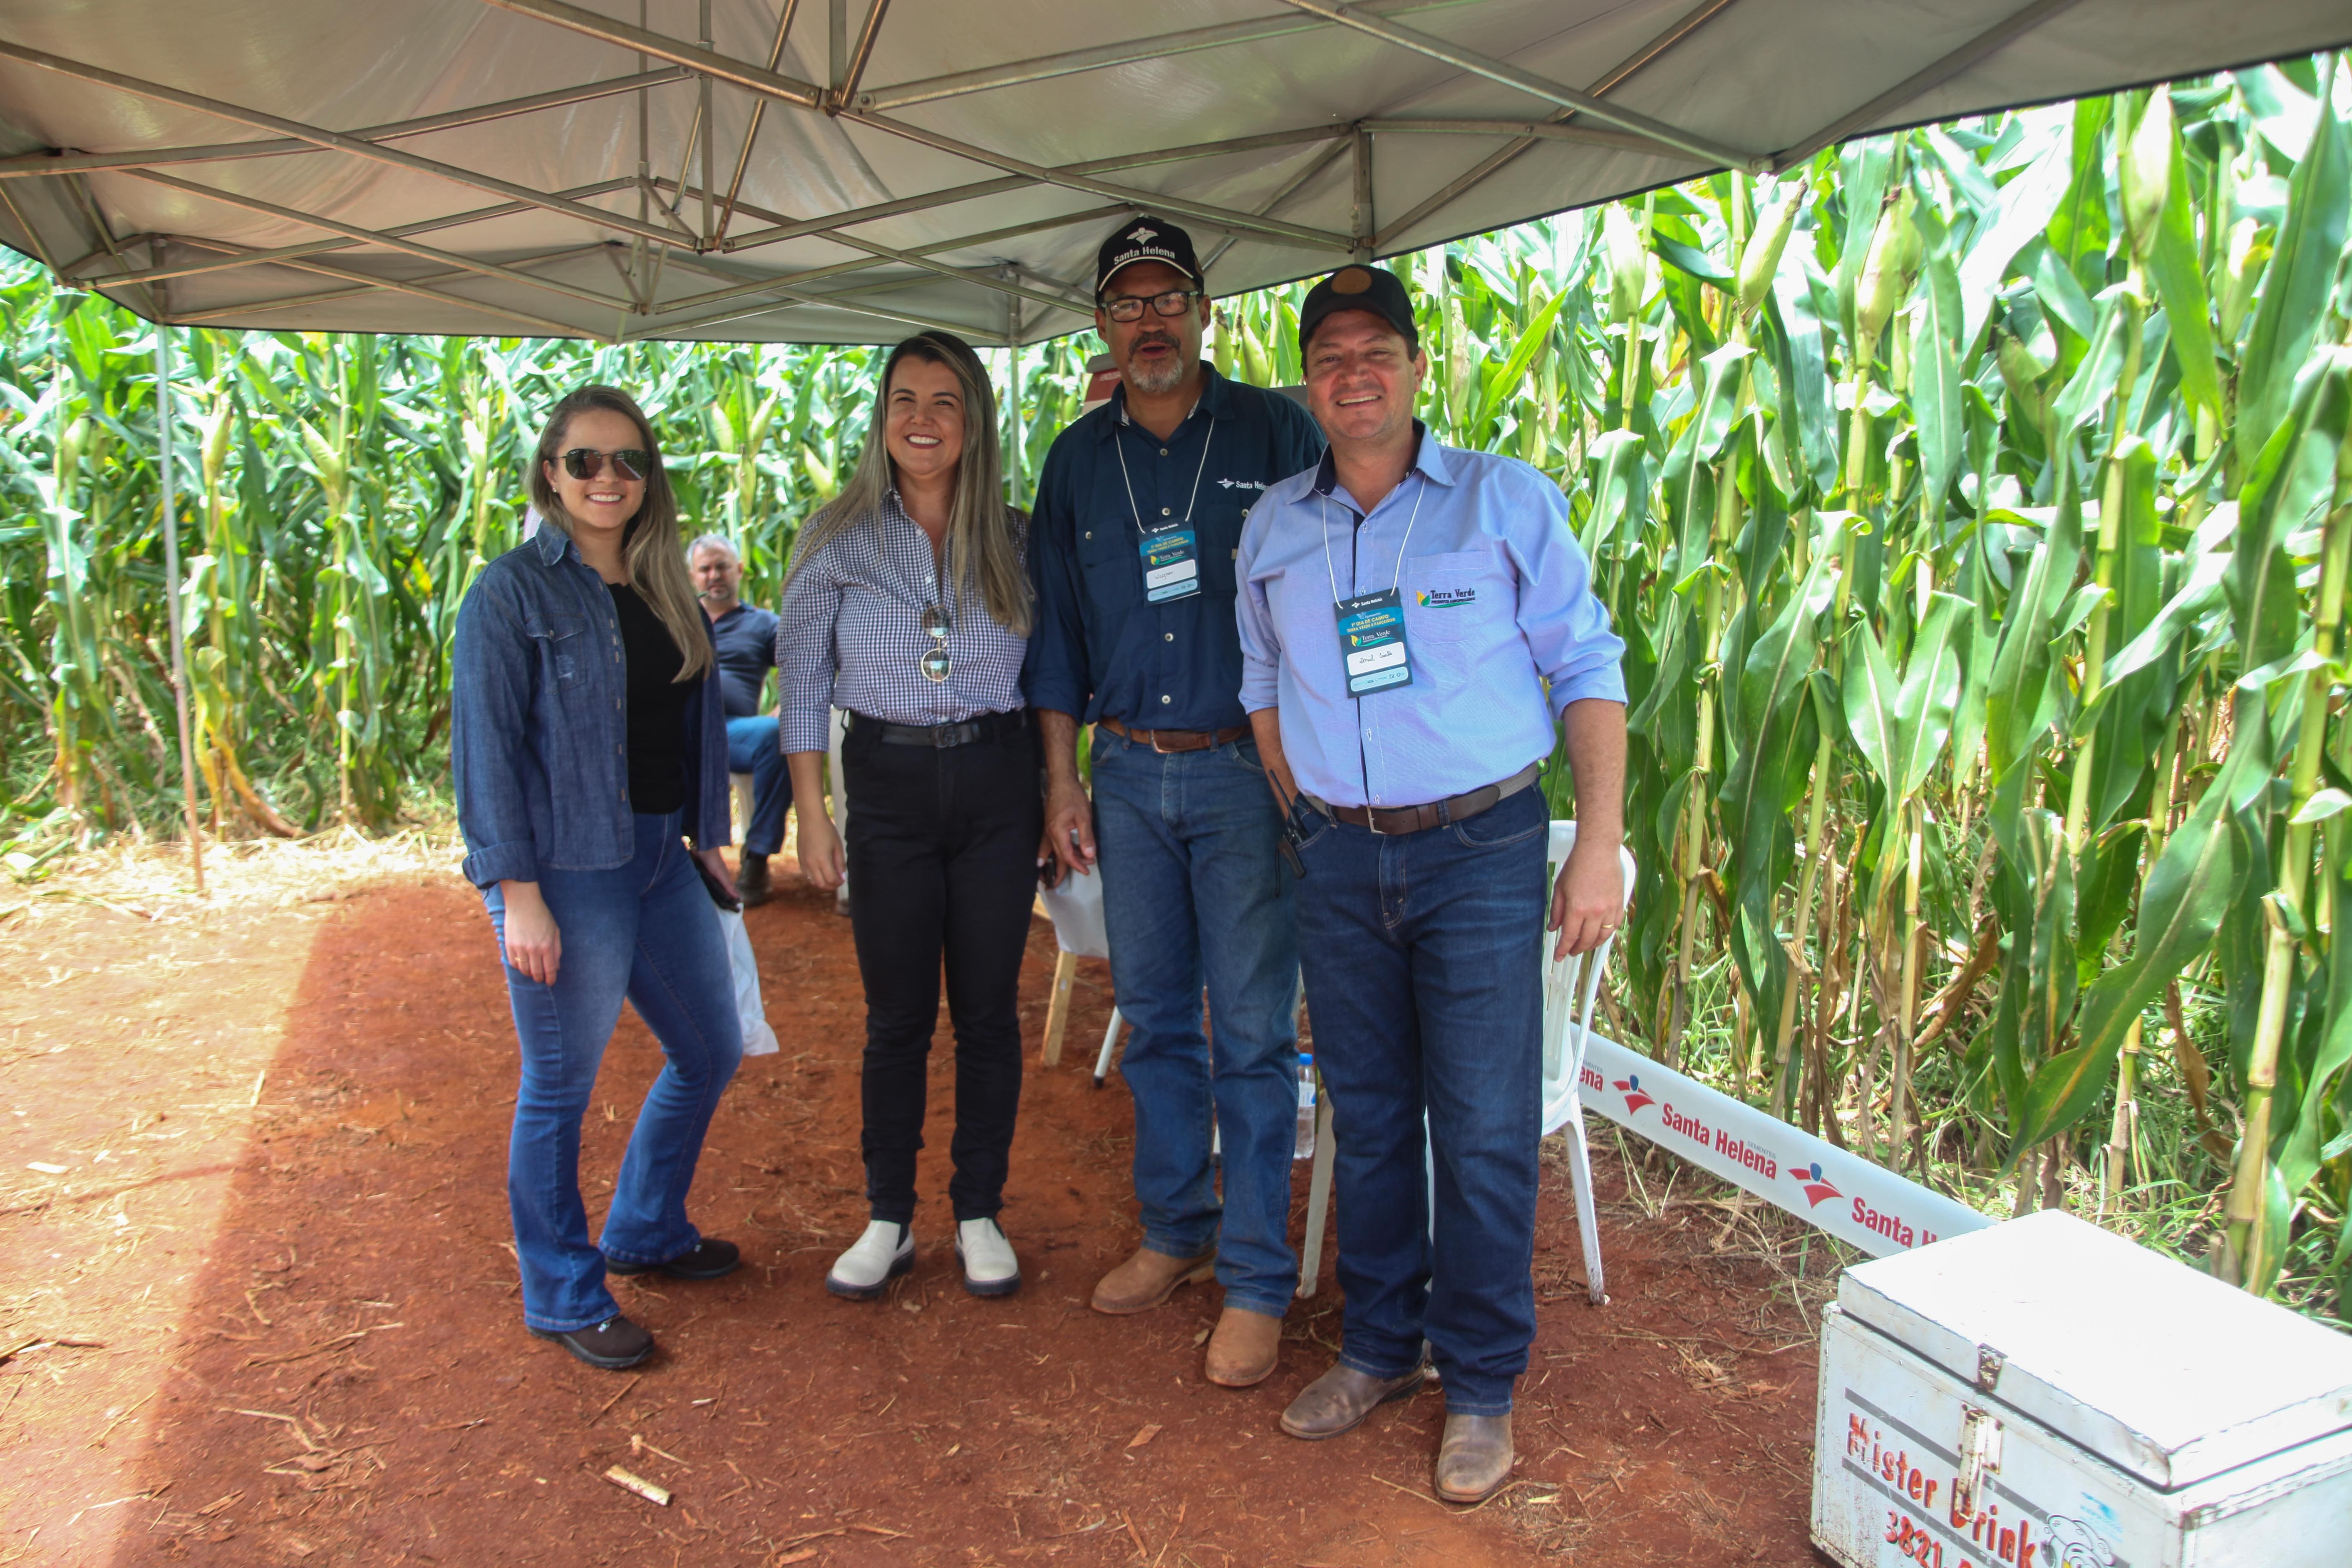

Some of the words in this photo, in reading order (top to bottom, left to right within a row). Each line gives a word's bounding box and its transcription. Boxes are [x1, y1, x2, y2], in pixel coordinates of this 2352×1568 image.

[1114, 249, 1139, 265] Santa
[1142, 246, 1175, 259] Helena
[1236, 481, 1253, 489] Santa
[1254, 481, 1269, 490] Helen
[1430, 590, 1452, 599] Terra
[1455, 588, 1475, 598] Verde
[1579, 1065, 1604, 1093] ena
[1662, 1102, 1710, 1146] Santa
[1715, 1128, 1777, 1180] Helena
[1747, 1140, 1776, 1159] SEMENTES
[1851, 1196, 1914, 1248] Santa
[1847, 1412, 1937, 1509] Mister
